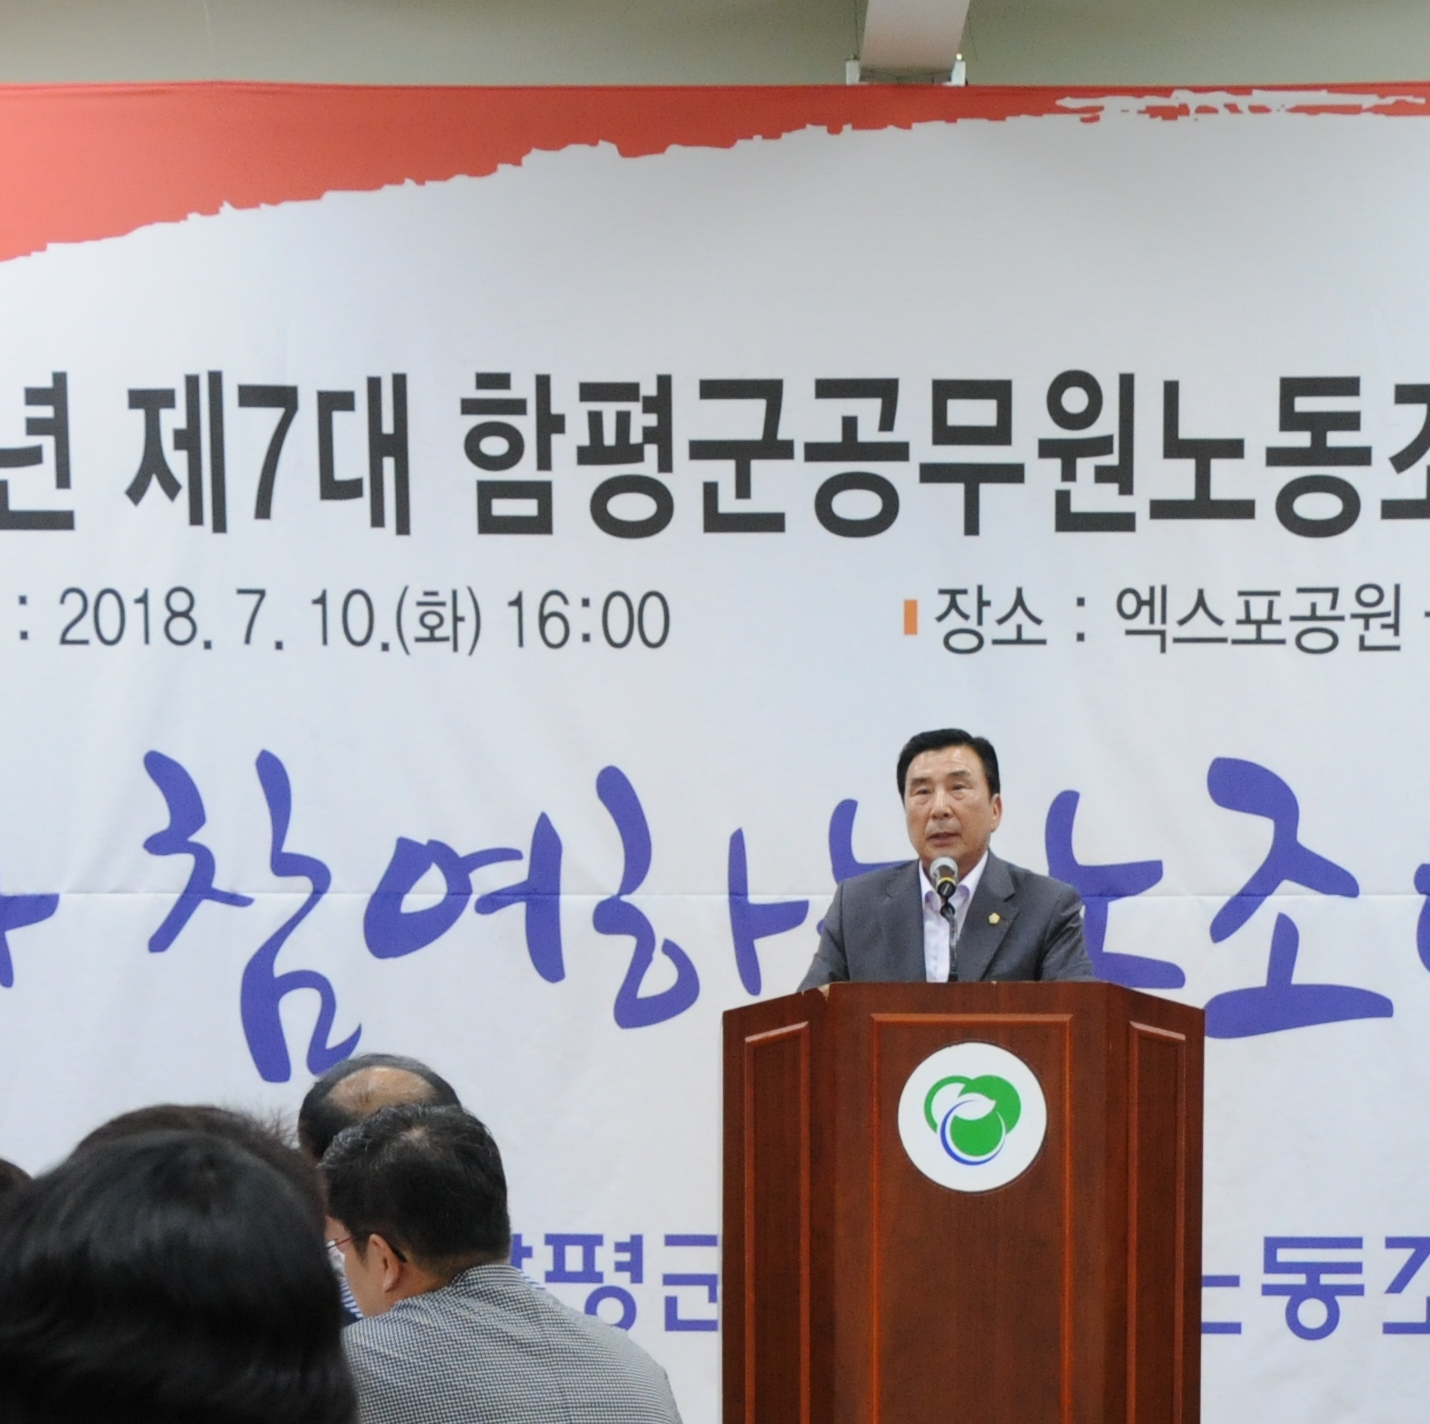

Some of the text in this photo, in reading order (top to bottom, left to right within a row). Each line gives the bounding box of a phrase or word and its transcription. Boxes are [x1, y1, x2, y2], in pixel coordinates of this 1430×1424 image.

[125, 371, 411, 536] 제7대
[508, 589, 671, 650] 16:00
[935, 584, 1047, 655] 장소
[1116, 583, 1401, 655] 엑스포공원
